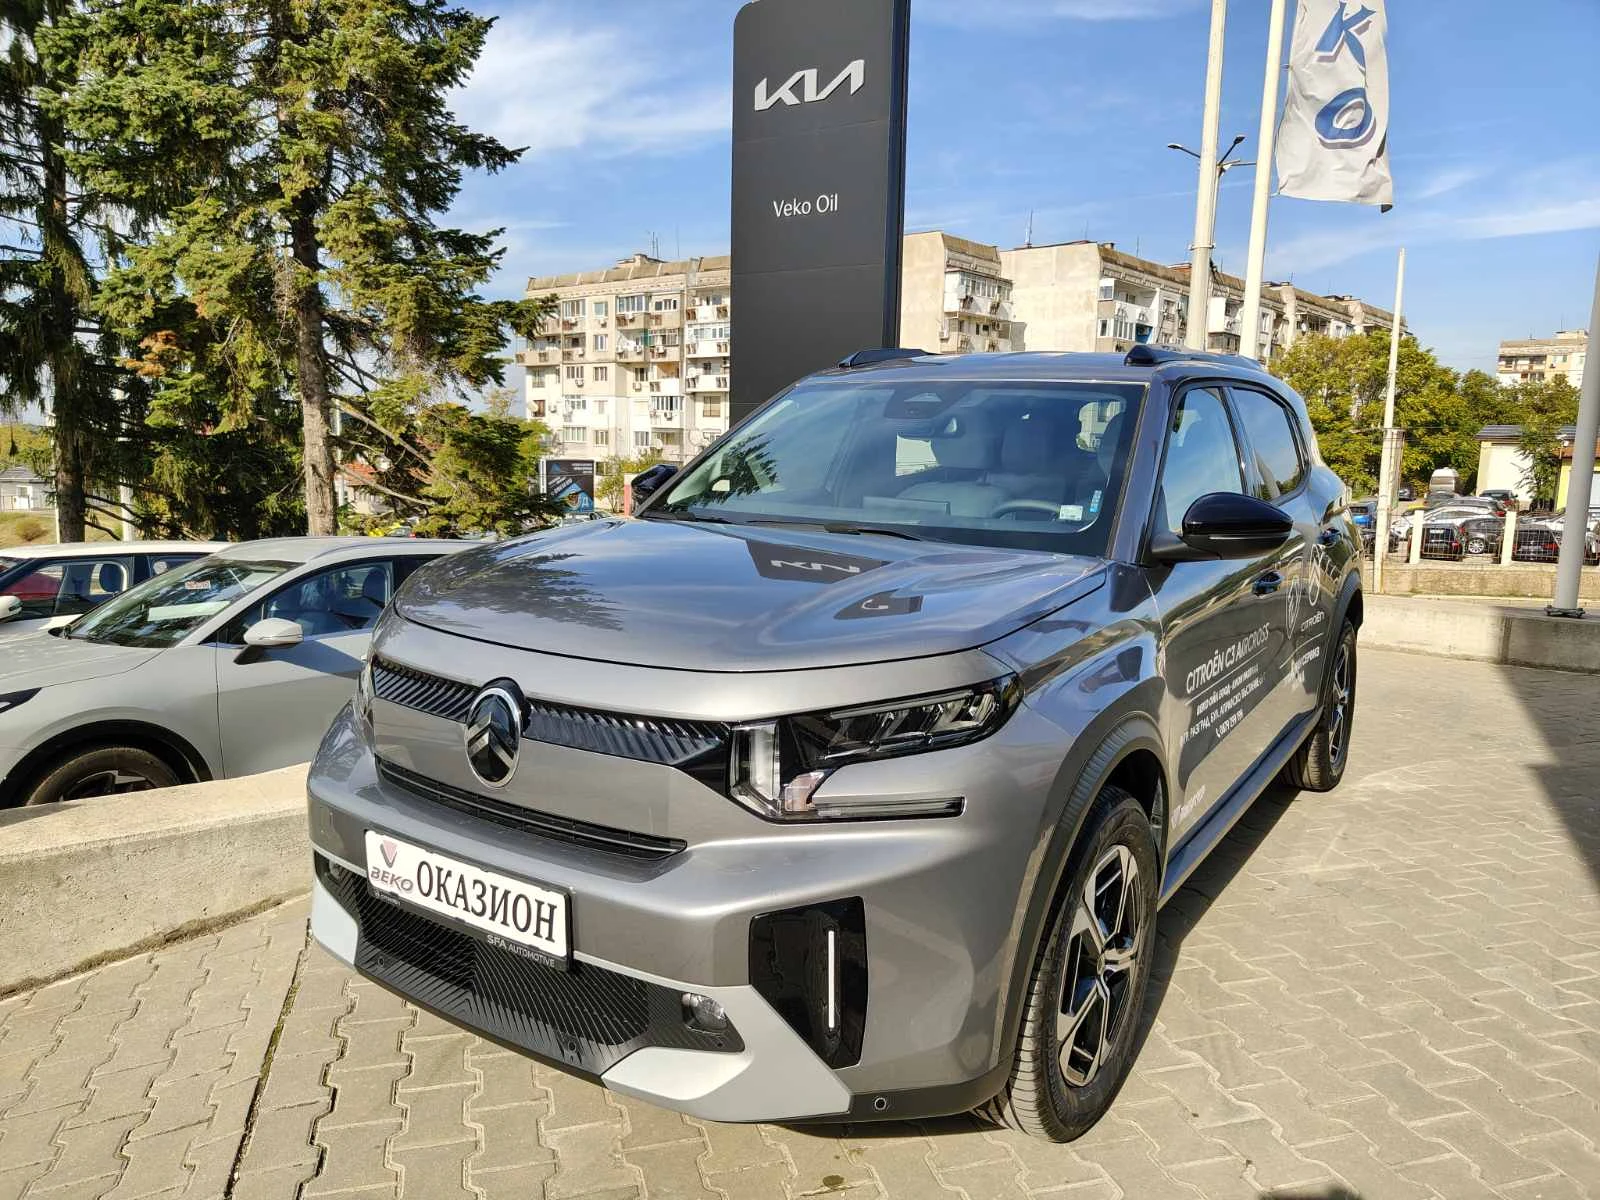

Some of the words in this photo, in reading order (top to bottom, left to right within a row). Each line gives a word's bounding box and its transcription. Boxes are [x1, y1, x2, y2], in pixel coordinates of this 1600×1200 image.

[754, 59, 865, 111] KIA
[773, 198, 811, 217] Veko
[816, 193, 839, 213] Oil
[1186, 649, 1225, 694] CITROËN
[370, 866, 414, 894] ВЕКО
[416, 861, 558, 943] ОКАЗИОН
[487, 934, 507, 950] SFA
[508, 944, 555, 968] AUTOMOTIVE
